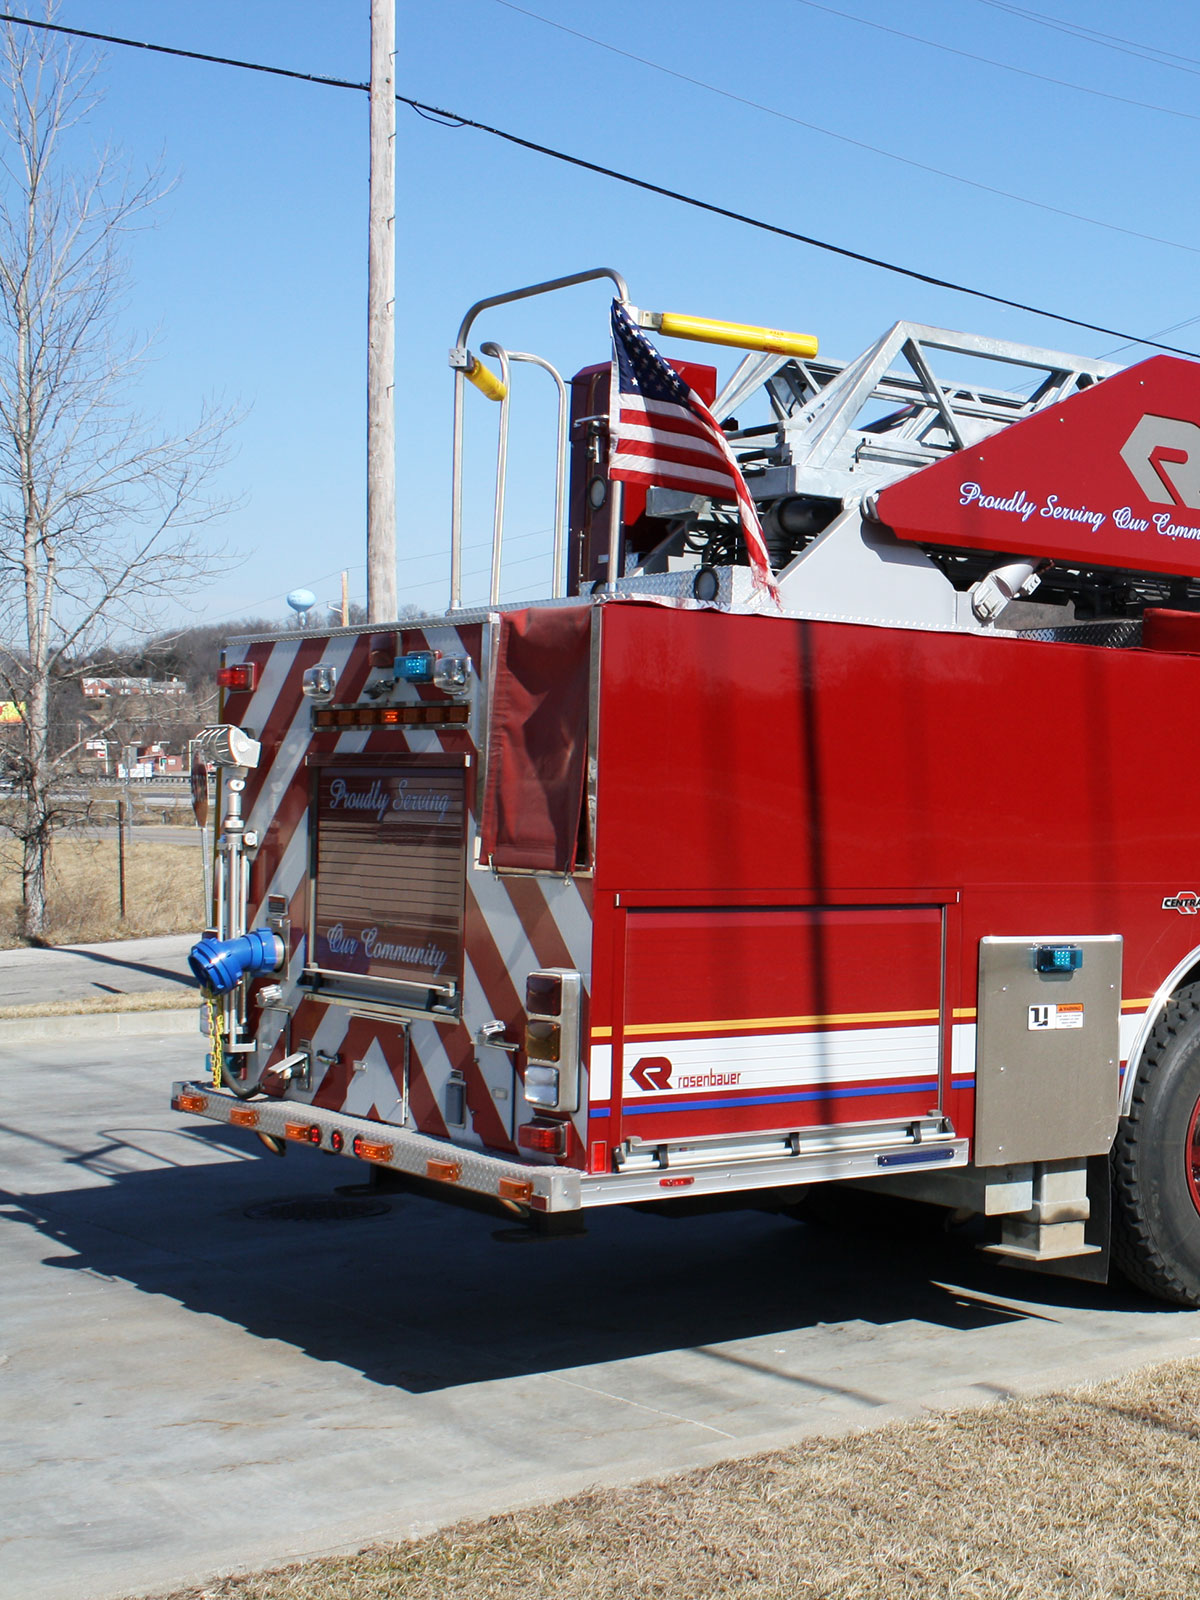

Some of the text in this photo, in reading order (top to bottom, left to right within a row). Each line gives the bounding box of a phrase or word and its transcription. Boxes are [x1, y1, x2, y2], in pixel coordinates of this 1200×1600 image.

[959, 481, 1037, 522] Proudly
[1040, 494, 1106, 532] Serving
[1112, 506, 1149, 532] Our
[329, 778, 449, 822] Proudly Serving
[327, 922, 447, 978] Our Community
[678, 1067, 741, 1089] rosenbauer
